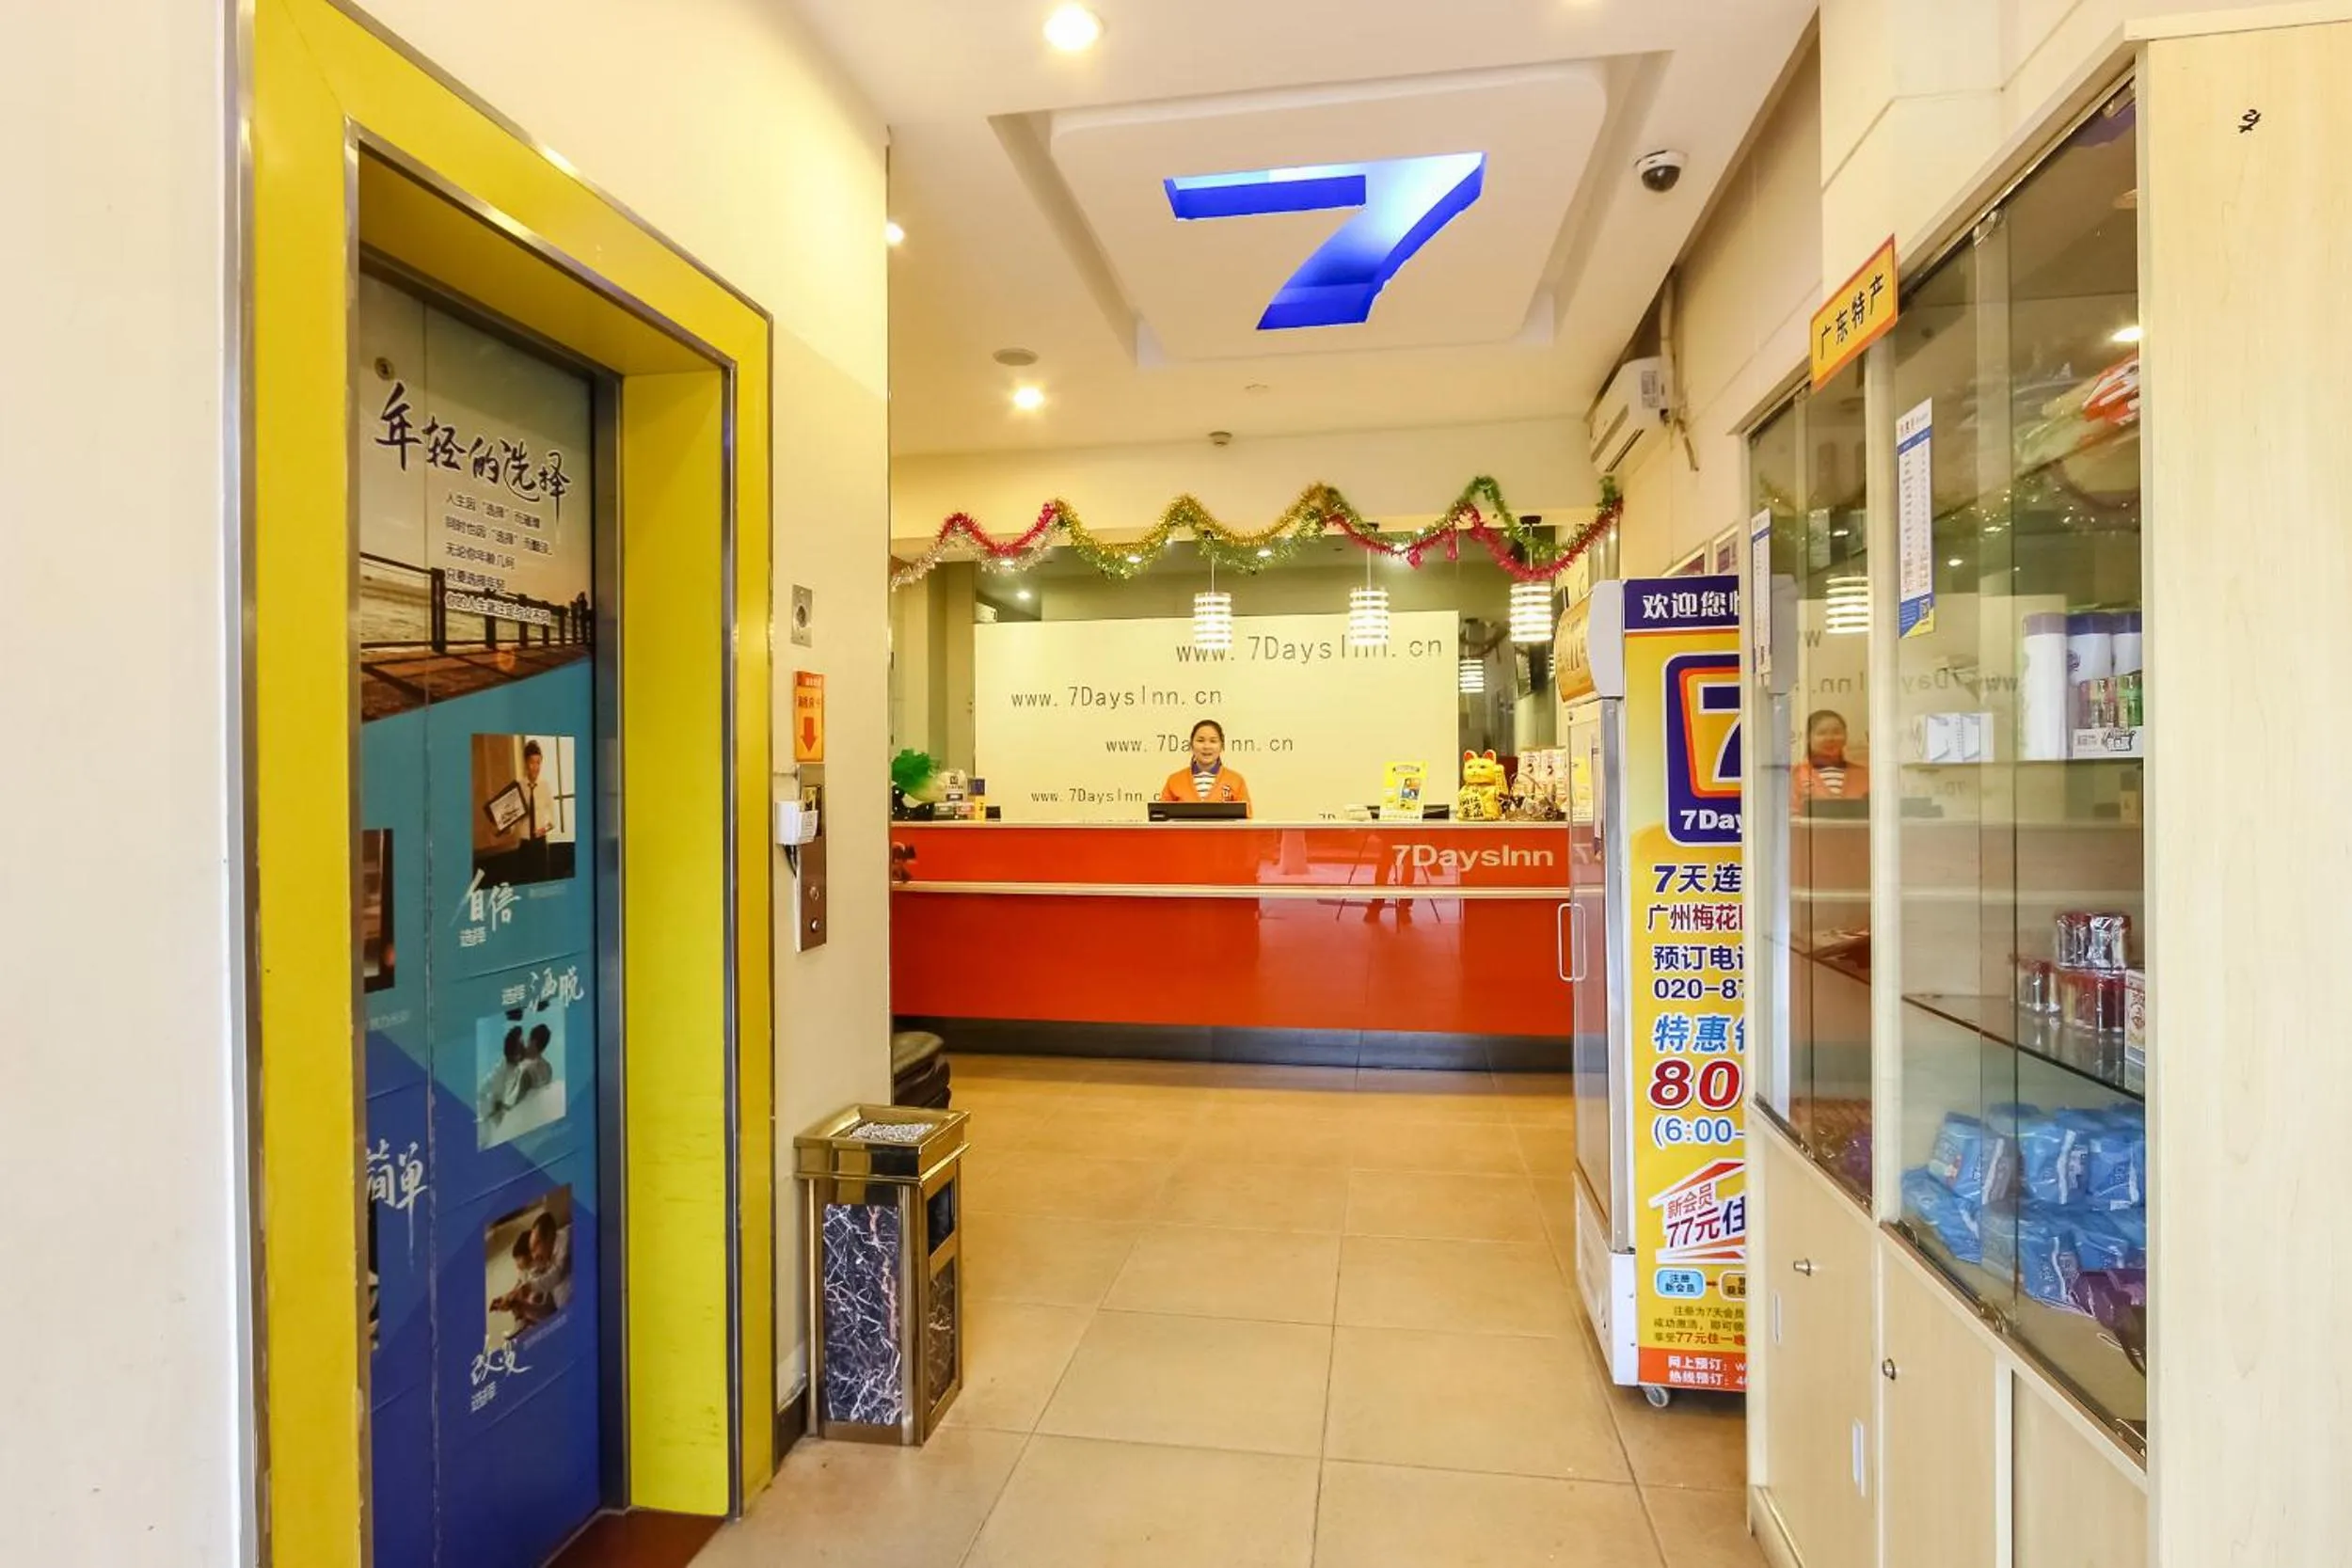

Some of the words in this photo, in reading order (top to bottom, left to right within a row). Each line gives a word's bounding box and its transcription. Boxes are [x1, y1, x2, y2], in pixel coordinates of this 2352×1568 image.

[1163, 150, 1487, 330] 7
[1820, 274, 1883, 360] 广东特产
[374, 381, 570, 524] 年轻的选择
[1011, 685, 1222, 709] www.7DaysInn.cn
[1391, 845, 1553, 872] 7DaysInn
[1654, 863, 1742, 893] 7天连
[1648, 904, 1742, 930] 广州梅花
[1654, 945, 1743, 970] 预订电
[1650, 1059, 1740, 1108] 80
[1668, 1182, 1712, 1218] 新会员
